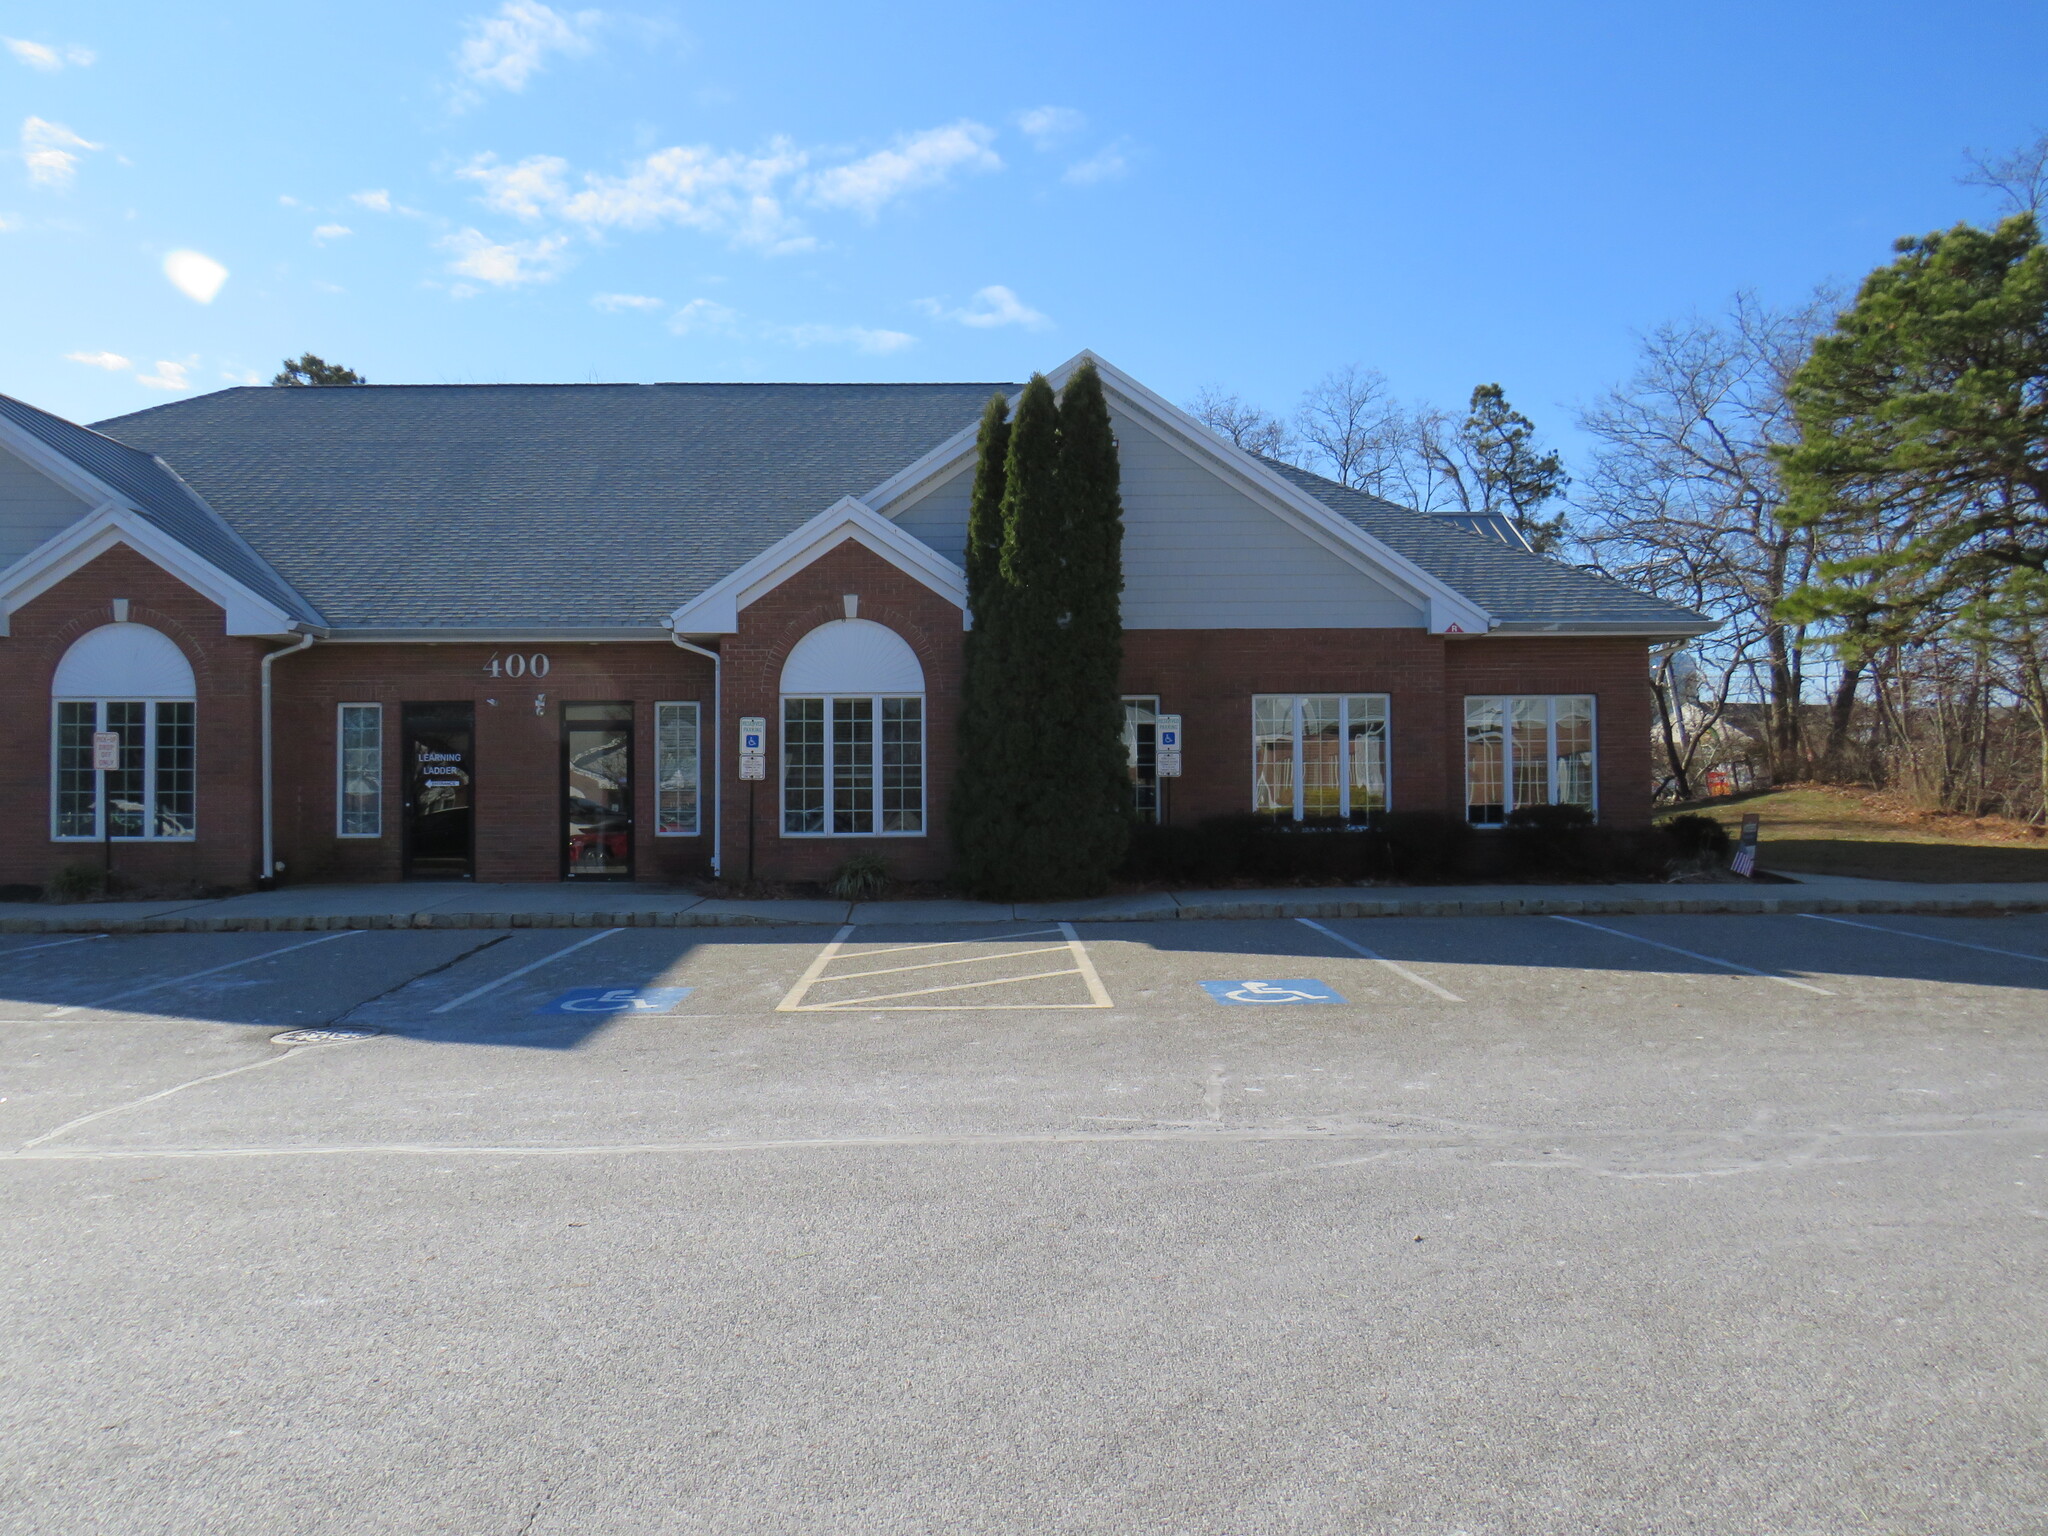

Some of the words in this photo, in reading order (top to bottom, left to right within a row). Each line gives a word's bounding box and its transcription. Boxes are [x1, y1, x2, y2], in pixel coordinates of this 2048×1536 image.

[482, 651, 550, 678] 400
[418, 753, 461, 762] LEARNING
[423, 766, 457, 775] LADDER
